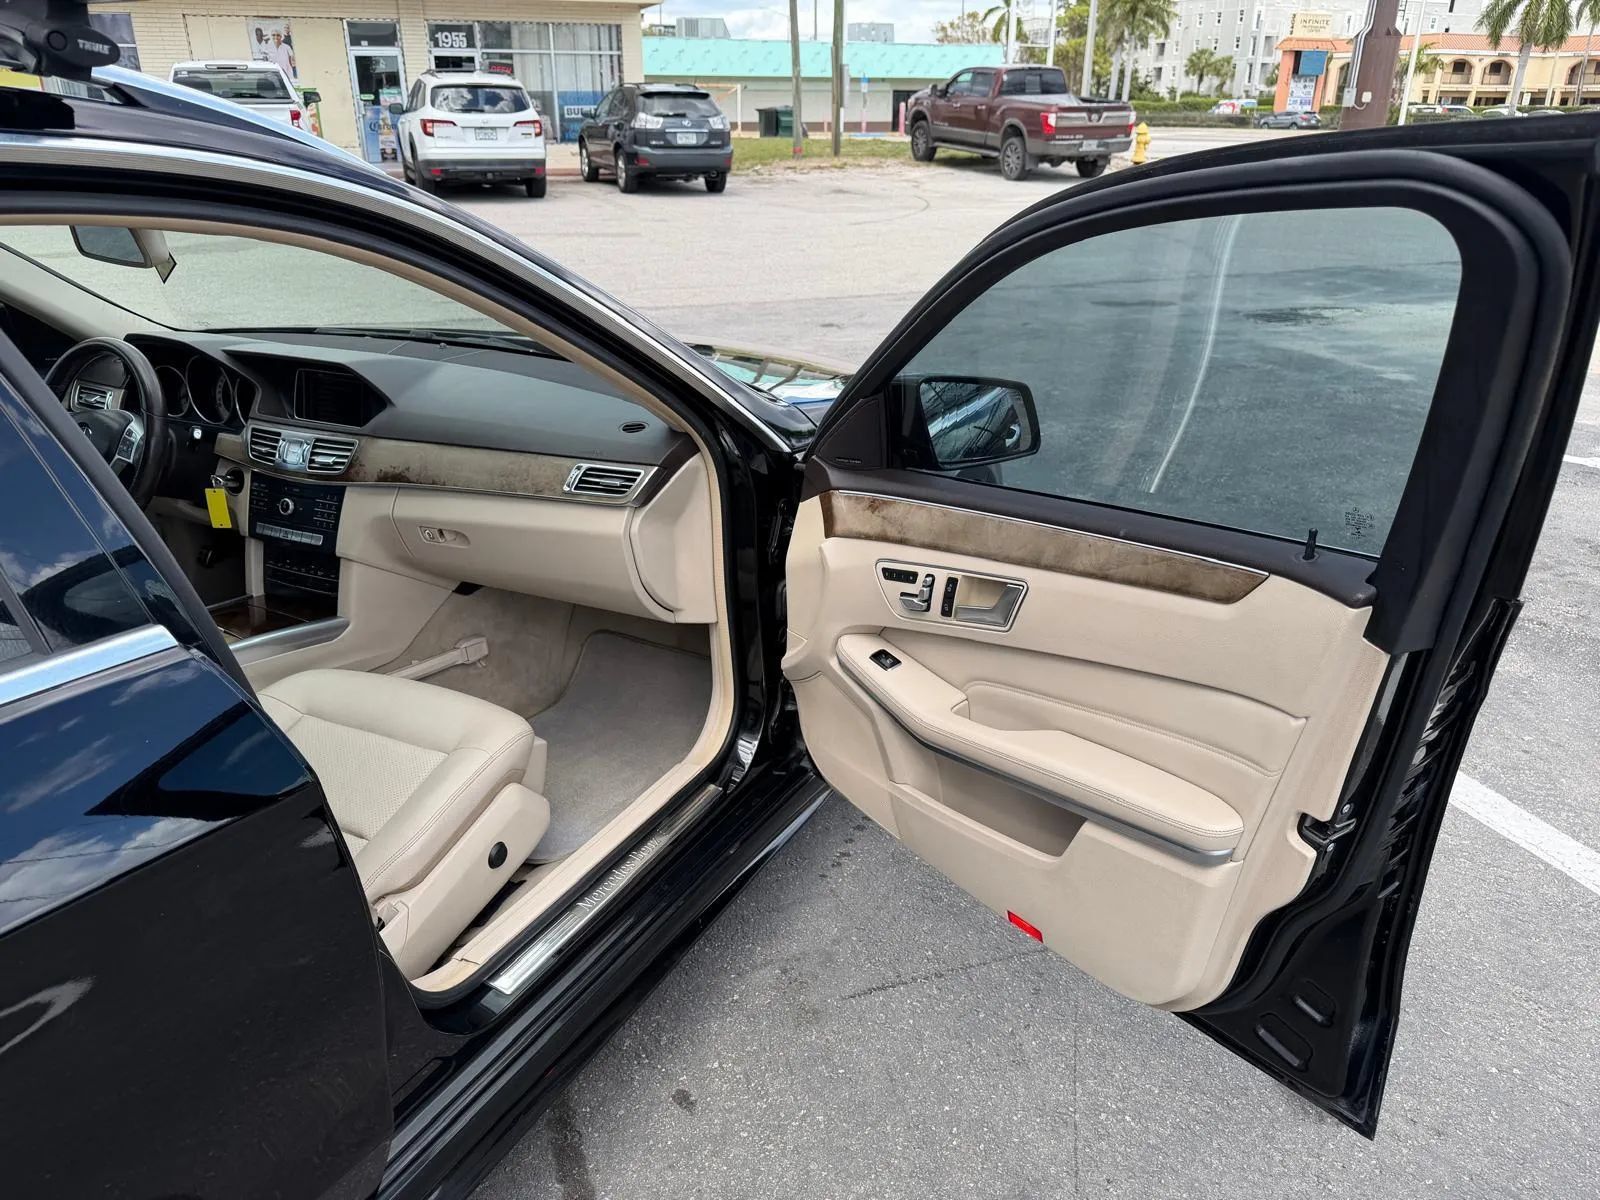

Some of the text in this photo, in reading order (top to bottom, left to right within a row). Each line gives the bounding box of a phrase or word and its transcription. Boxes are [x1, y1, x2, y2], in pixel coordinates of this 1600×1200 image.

[1300, 18, 1331, 26] INFINITE
[77, 39, 111, 55] THULE
[435, 31, 467, 48] 1955
